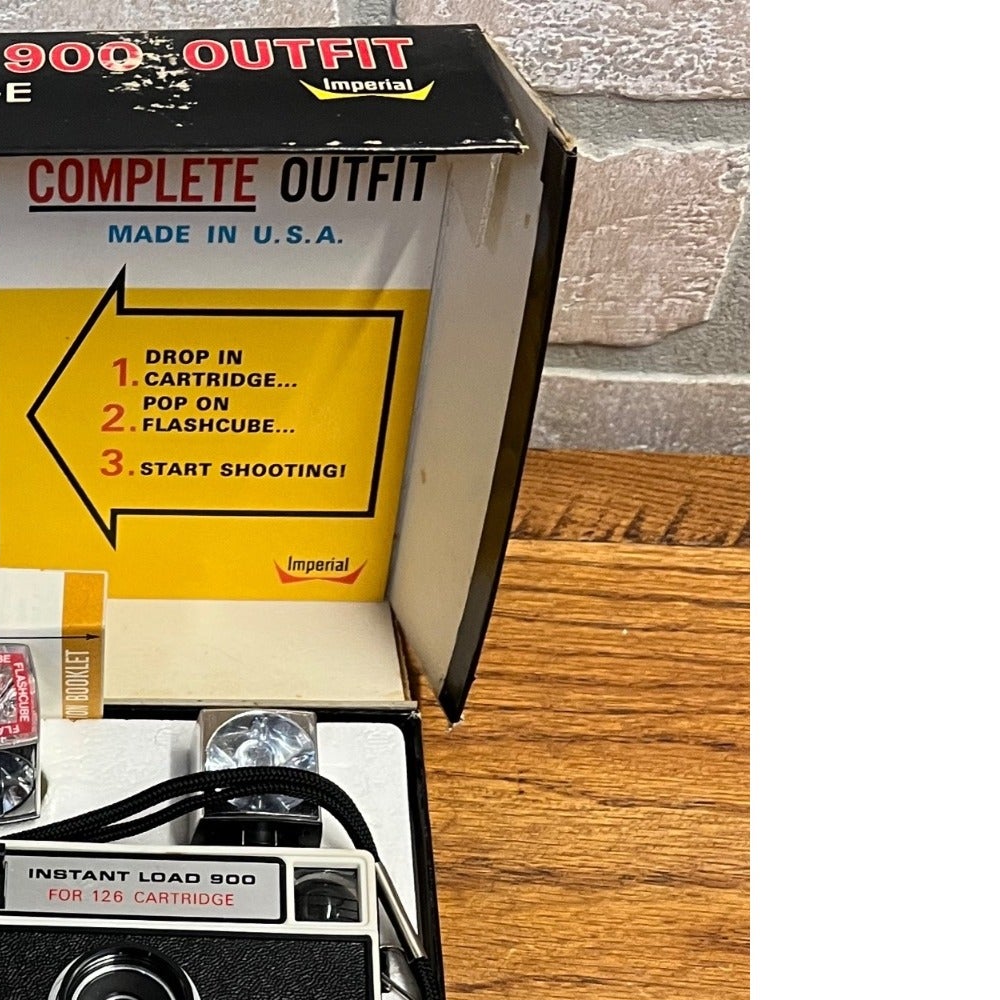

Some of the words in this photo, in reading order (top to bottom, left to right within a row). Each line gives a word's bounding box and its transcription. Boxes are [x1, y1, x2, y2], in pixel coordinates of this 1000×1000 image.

[3, 41, 143, 73] 900
[184, 37, 413, 71] OUTFIT
[324, 77, 413, 93] Imperial
[29, 156, 259, 204] COMPLETE
[280, 154, 437, 202] OUTFIT
[108, 224, 190, 244] MADE
[208, 225, 236, 244] IN
[253, 225, 344, 244] U.S.A.
[112, 358, 139, 387] 1.
[145, 349, 210, 365] DROP
[218, 350, 243, 365] IN
[144, 372, 298, 388] CARTRIDGE...
[143, 396, 188, 411] POP
[196, 396, 229, 411] ON
[101, 403, 136, 432] 2.
[142, 418, 295, 434] FLASHCUBE...
[100, 449, 135, 477] 3.
[140, 462, 212, 476] START
[220, 463, 346, 478] SHOOTING!
[287, 556, 349, 574] Imperial
[65, 649, 89, 701] BOOKLET
[13, 662, 30, 722] FLASHCUBE
[29, 868, 130, 882] INSTANT
[139, 872, 200, 884] LOAD
[210, 874, 256, 885] 900
[48, 889, 82, 901] FOR
[93, 890, 123, 903] 126
[134, 891, 234, 906] CARTRIDGE
